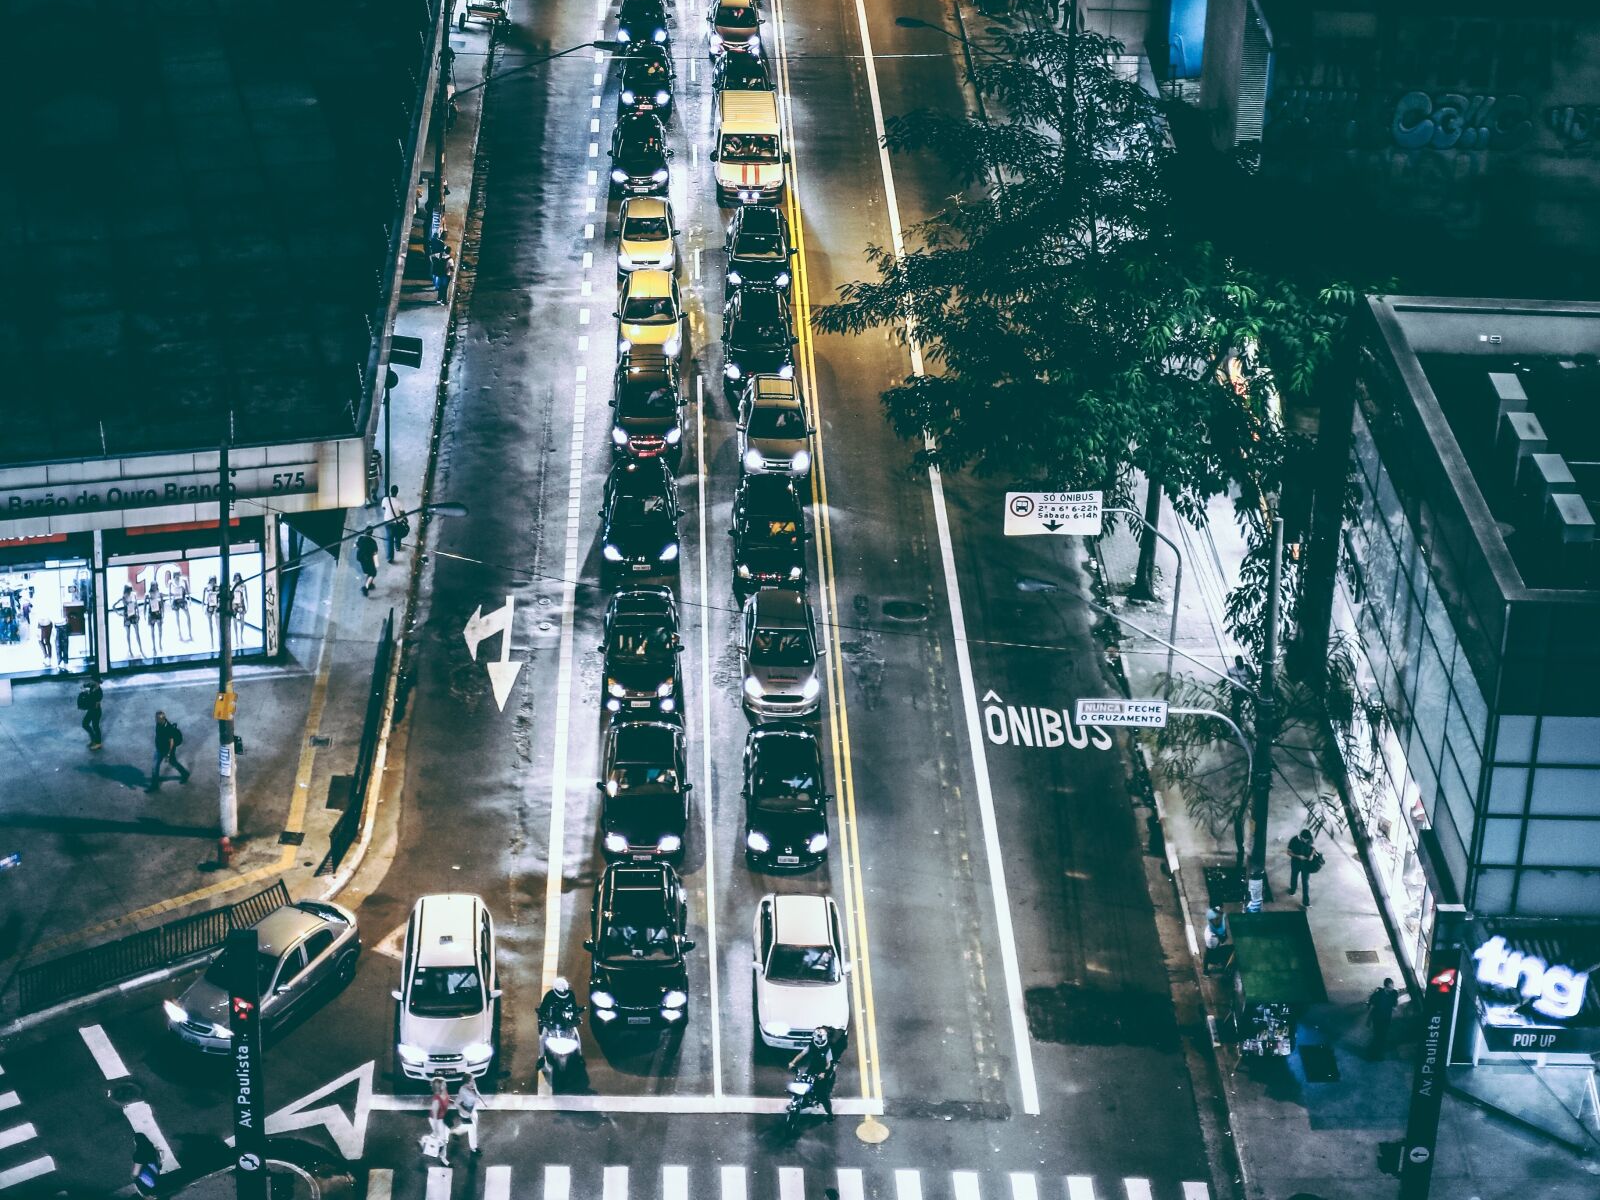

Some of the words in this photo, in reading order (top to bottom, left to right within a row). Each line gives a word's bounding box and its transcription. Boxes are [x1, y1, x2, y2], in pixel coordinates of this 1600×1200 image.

[8, 492, 69, 511] Barão
[76, 490, 101, 506] de
[107, 487, 157, 504] Ouro
[272, 472, 305, 490] 575
[1043, 493, 1056, 502] SÓ
[1060, 493, 1094, 502] ÔNIBUS
[1084, 703, 1122, 713] NUNCA
[1128, 705, 1162, 713] FECHE
[1091, 714, 1162, 723] CRUZAMENTO
[1421, 1016, 1441, 1074] Paulista
[1512, 1033, 1537, 1047] POP
[1539, 1034, 1556, 1047] UP
[236, 1045, 251, 1105] Paulista
[1419, 1078, 1433, 1096] Av.
[238, 1109, 252, 1128] Av.
